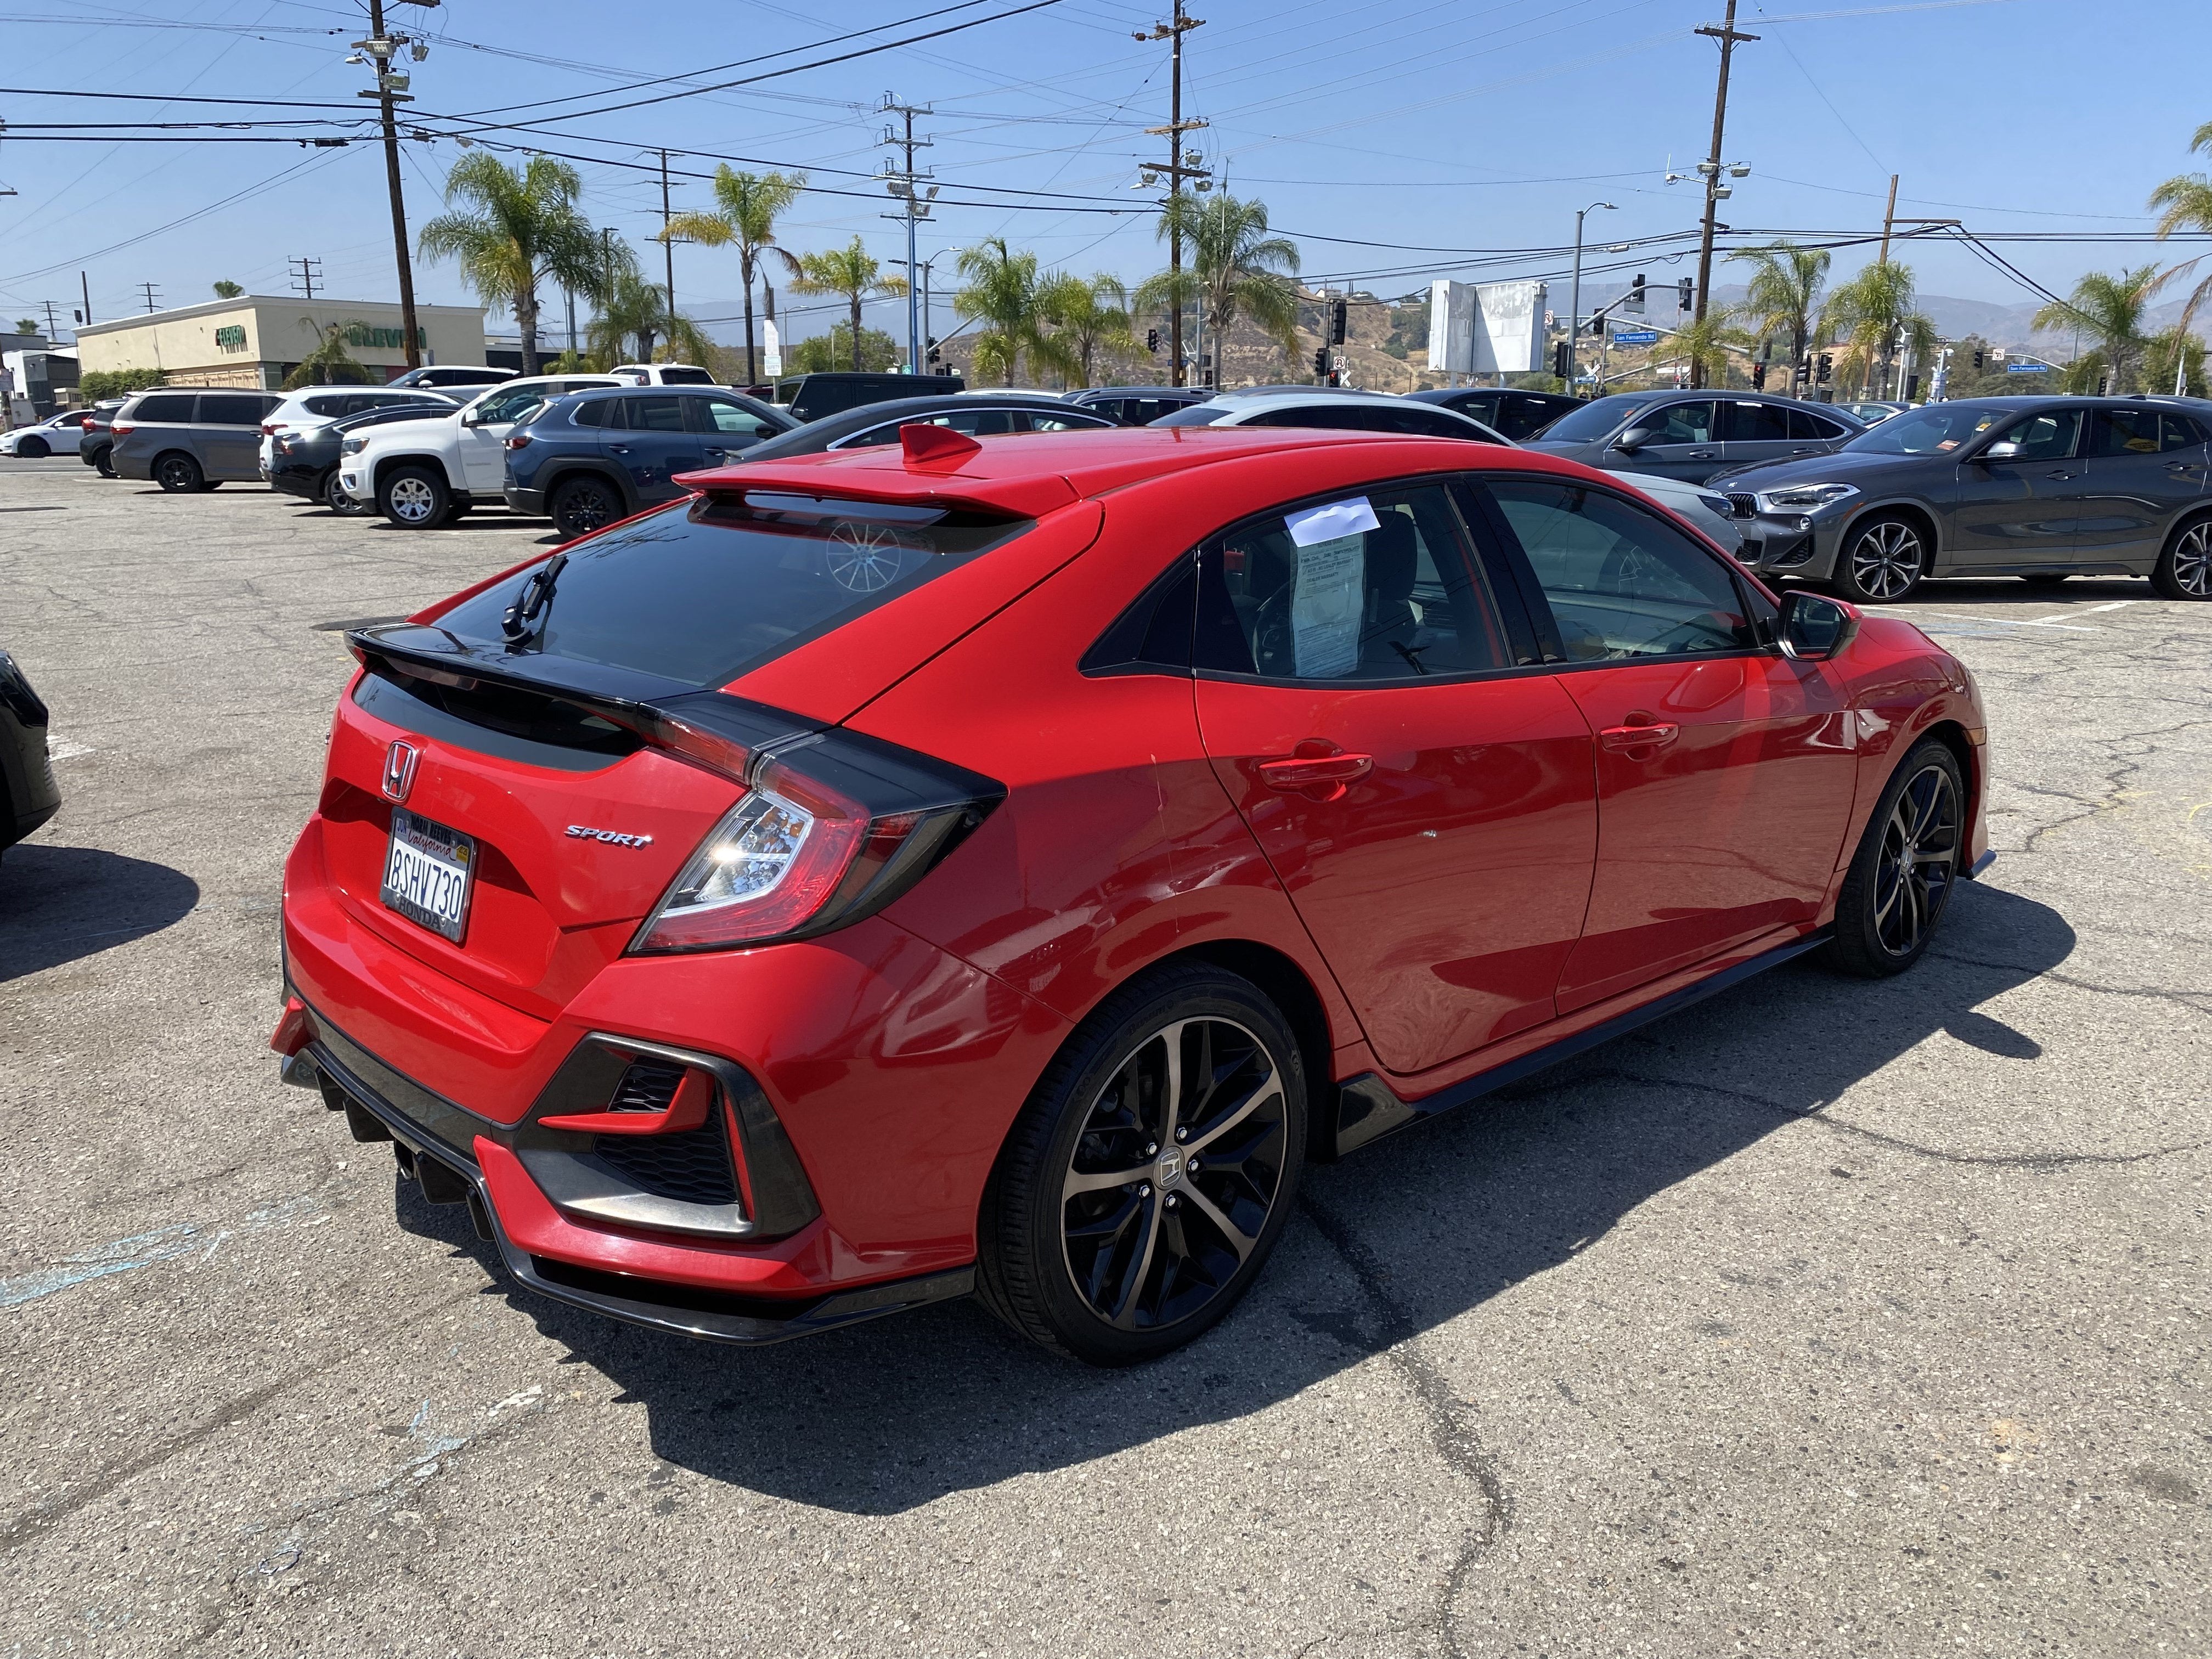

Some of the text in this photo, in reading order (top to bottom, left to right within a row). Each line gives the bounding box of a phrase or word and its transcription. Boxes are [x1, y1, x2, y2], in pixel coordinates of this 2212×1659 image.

[411, 815, 452, 844] NORM REEVES
[563, 825, 653, 847] SPORT
[408, 830, 456, 862] California
[391, 849, 462, 919] 8SHV730
[399, 896, 441, 930] HONDA
